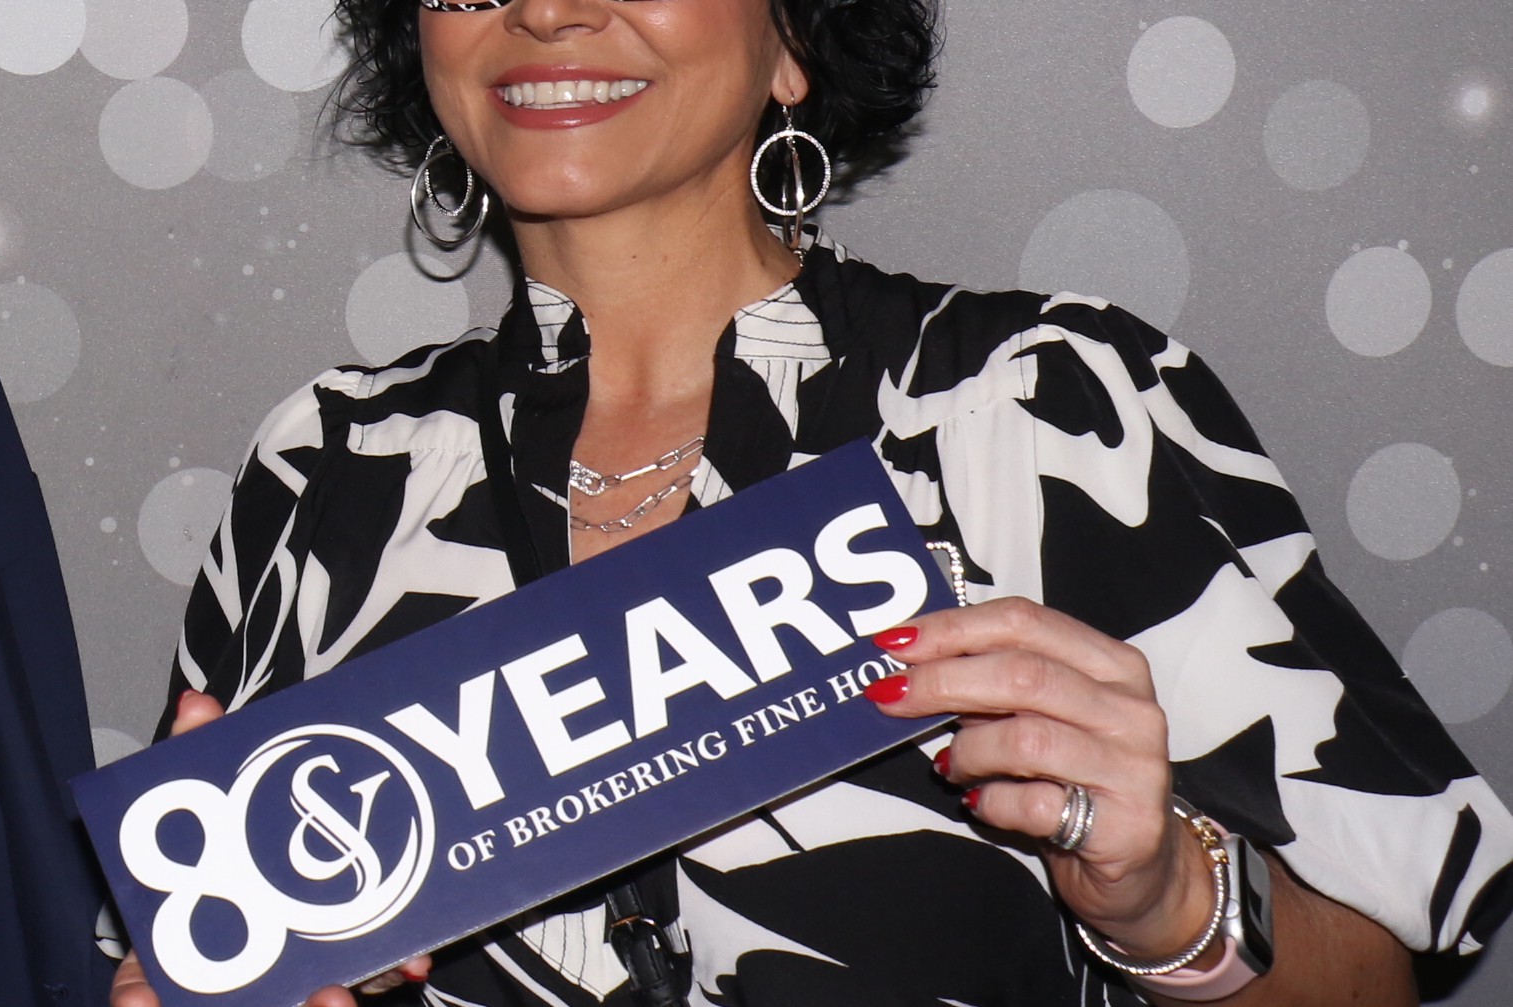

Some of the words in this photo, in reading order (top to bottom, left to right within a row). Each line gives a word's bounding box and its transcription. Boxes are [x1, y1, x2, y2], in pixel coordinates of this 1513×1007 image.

[383, 502, 928, 811] YEARS
[447, 829, 496, 871] OF
[503, 730, 727, 848] BROKERING
[731, 687, 826, 747] FINE
